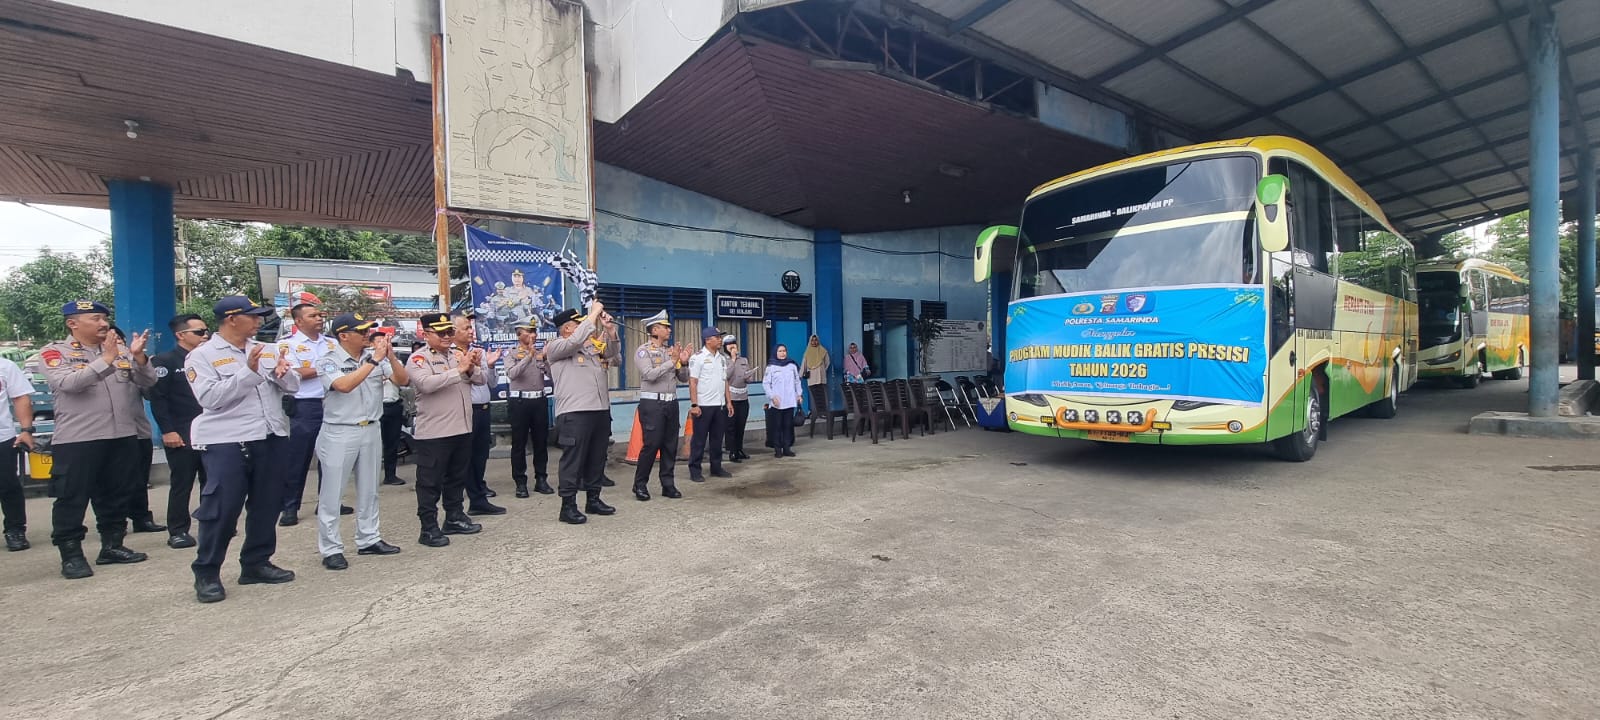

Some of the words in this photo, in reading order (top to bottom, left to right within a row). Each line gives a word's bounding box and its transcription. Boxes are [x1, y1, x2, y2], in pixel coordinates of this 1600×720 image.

[1071, 209, 1112, 225] SAMARINDA
[1116, 201, 1162, 216] BALIKPAPAN
[1162, 198, 1174, 208] PP
[1064, 317, 1102, 326] POLRESTA
[1105, 316, 1159, 324] SAMARINDA
[1009, 344, 1051, 363] PROGRAM
[1053, 344, 1092, 358] MUDIK
[1094, 343, 1132, 359] BALIK
[1134, 342, 1185, 359] GRATIS
[1187, 342, 1249, 363] PRESISI
[1069, 362, 1109, 377] TAHUN
[1111, 363, 1147, 378] 2026
